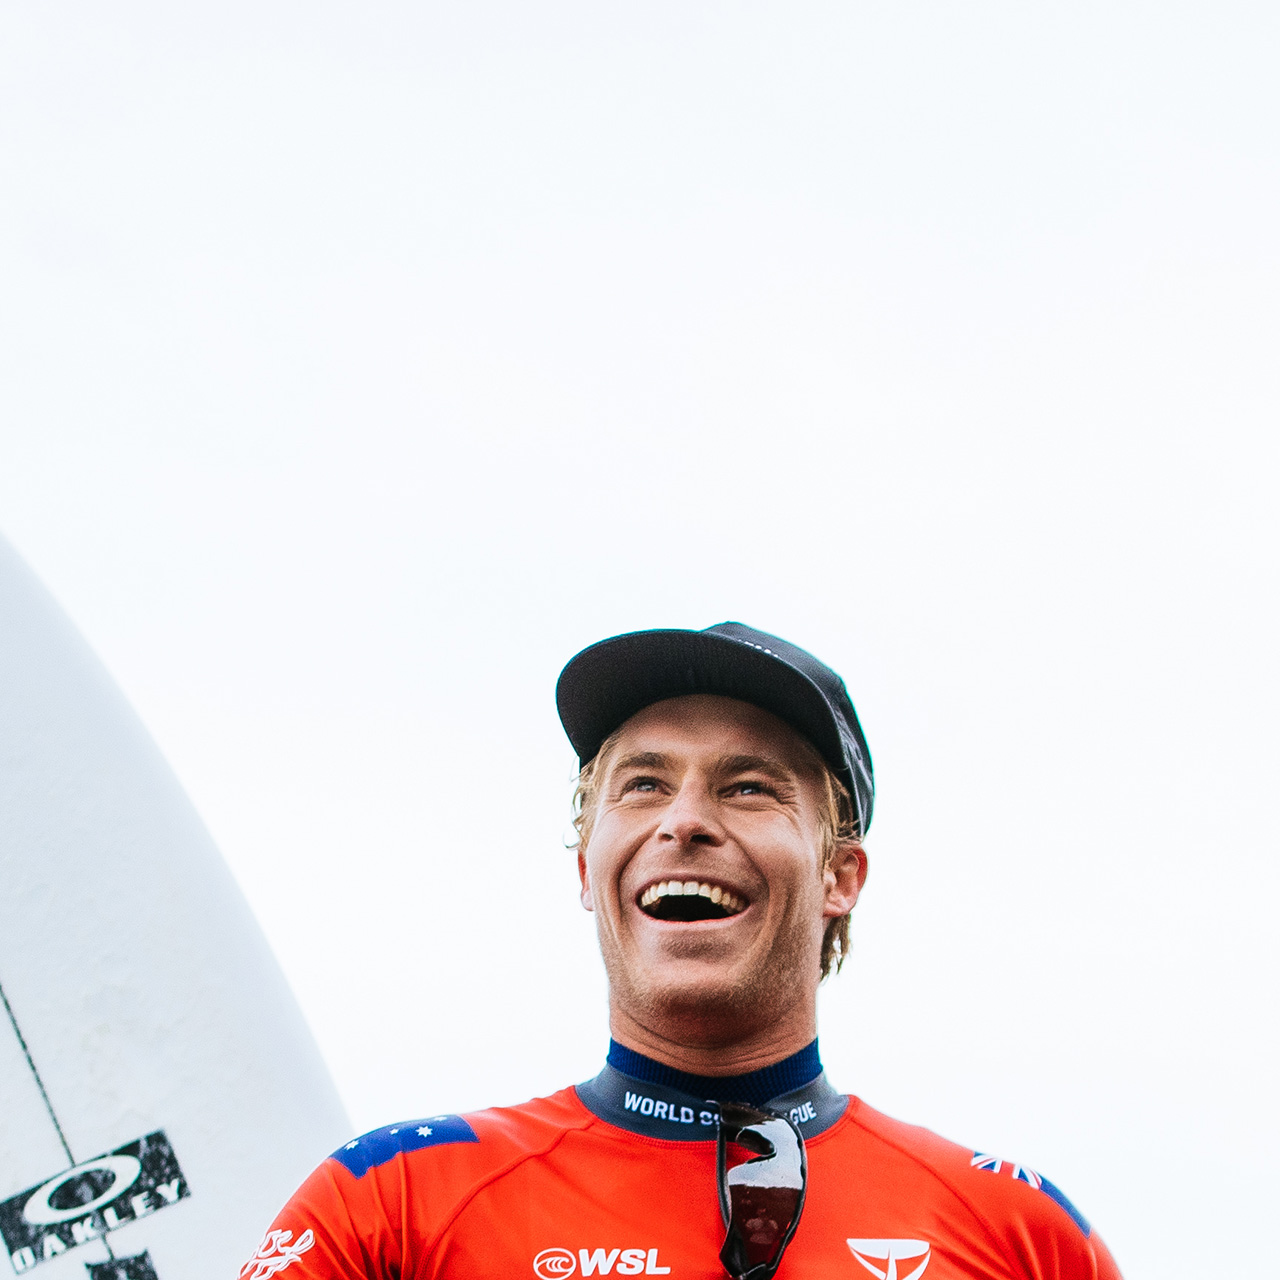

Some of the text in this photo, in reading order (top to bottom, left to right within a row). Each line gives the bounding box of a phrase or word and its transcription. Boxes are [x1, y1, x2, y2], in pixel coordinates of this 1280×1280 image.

[624, 1091, 694, 1124] WORLD
[11, 1177, 181, 1272] OAKLEY
[578, 1248, 671, 1277] WSL
